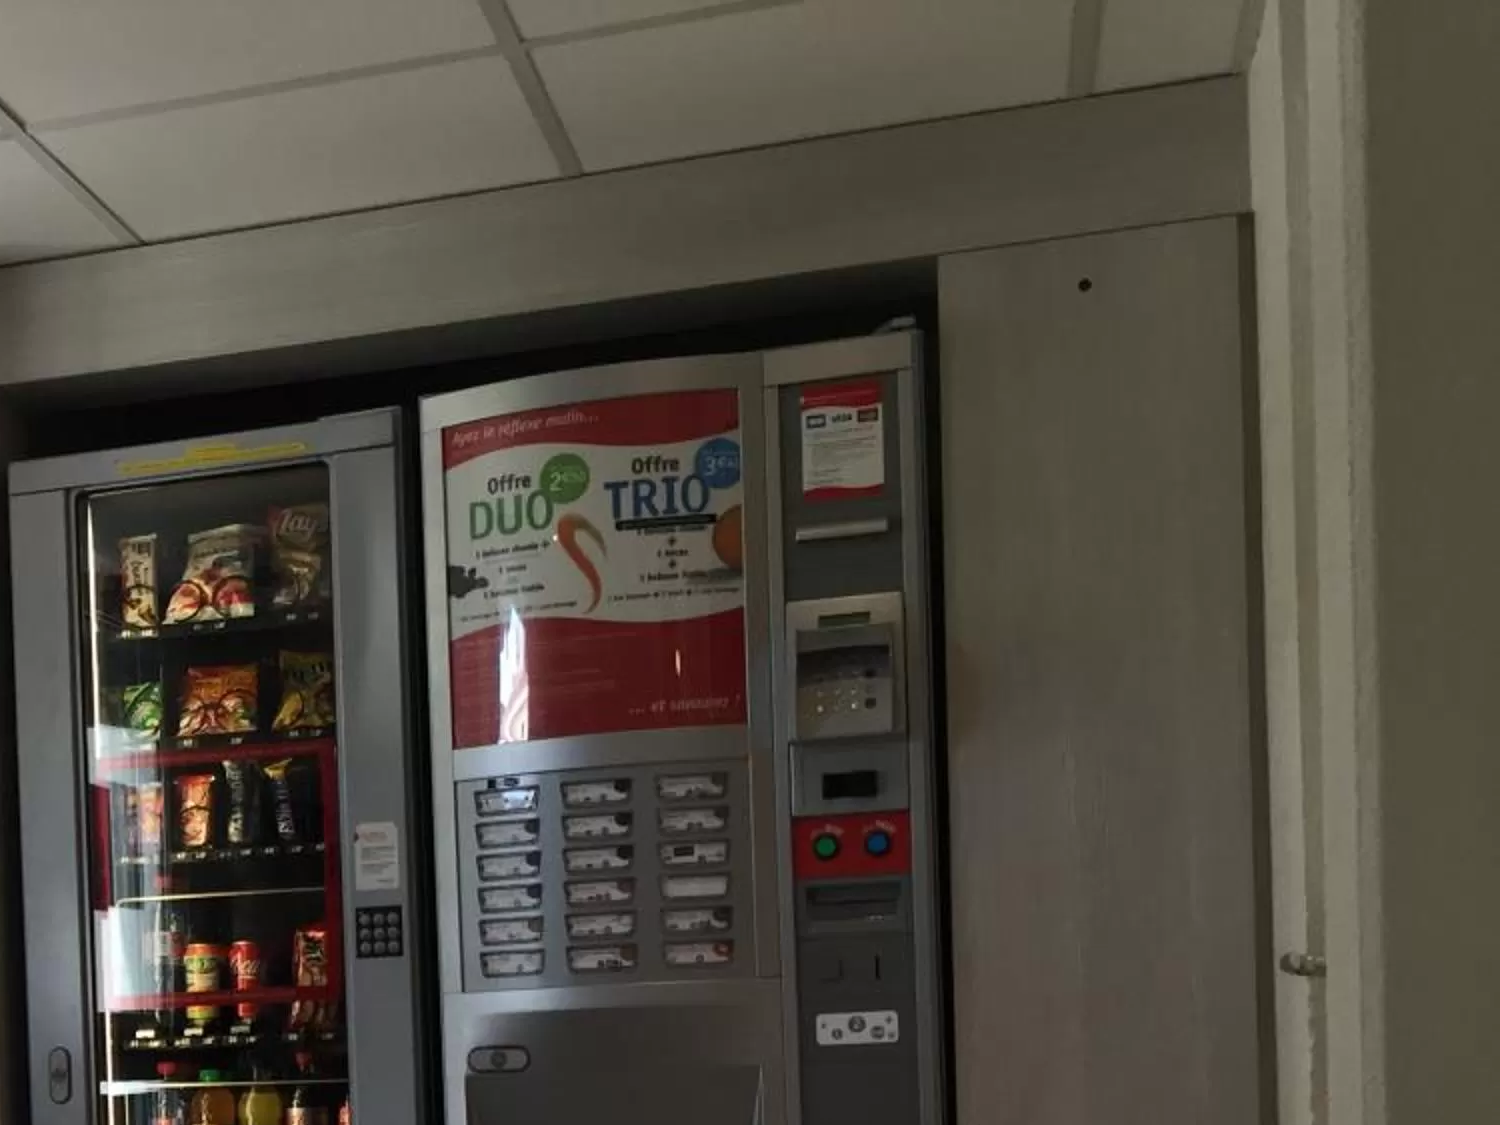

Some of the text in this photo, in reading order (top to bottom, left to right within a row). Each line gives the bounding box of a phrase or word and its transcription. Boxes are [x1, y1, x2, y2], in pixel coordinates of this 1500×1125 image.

[631, 455, 680, 475] Offre
[487, 473, 532, 494] Offre
[605, 475, 709, 518] TRIO
[470, 489, 552, 540] DUO
